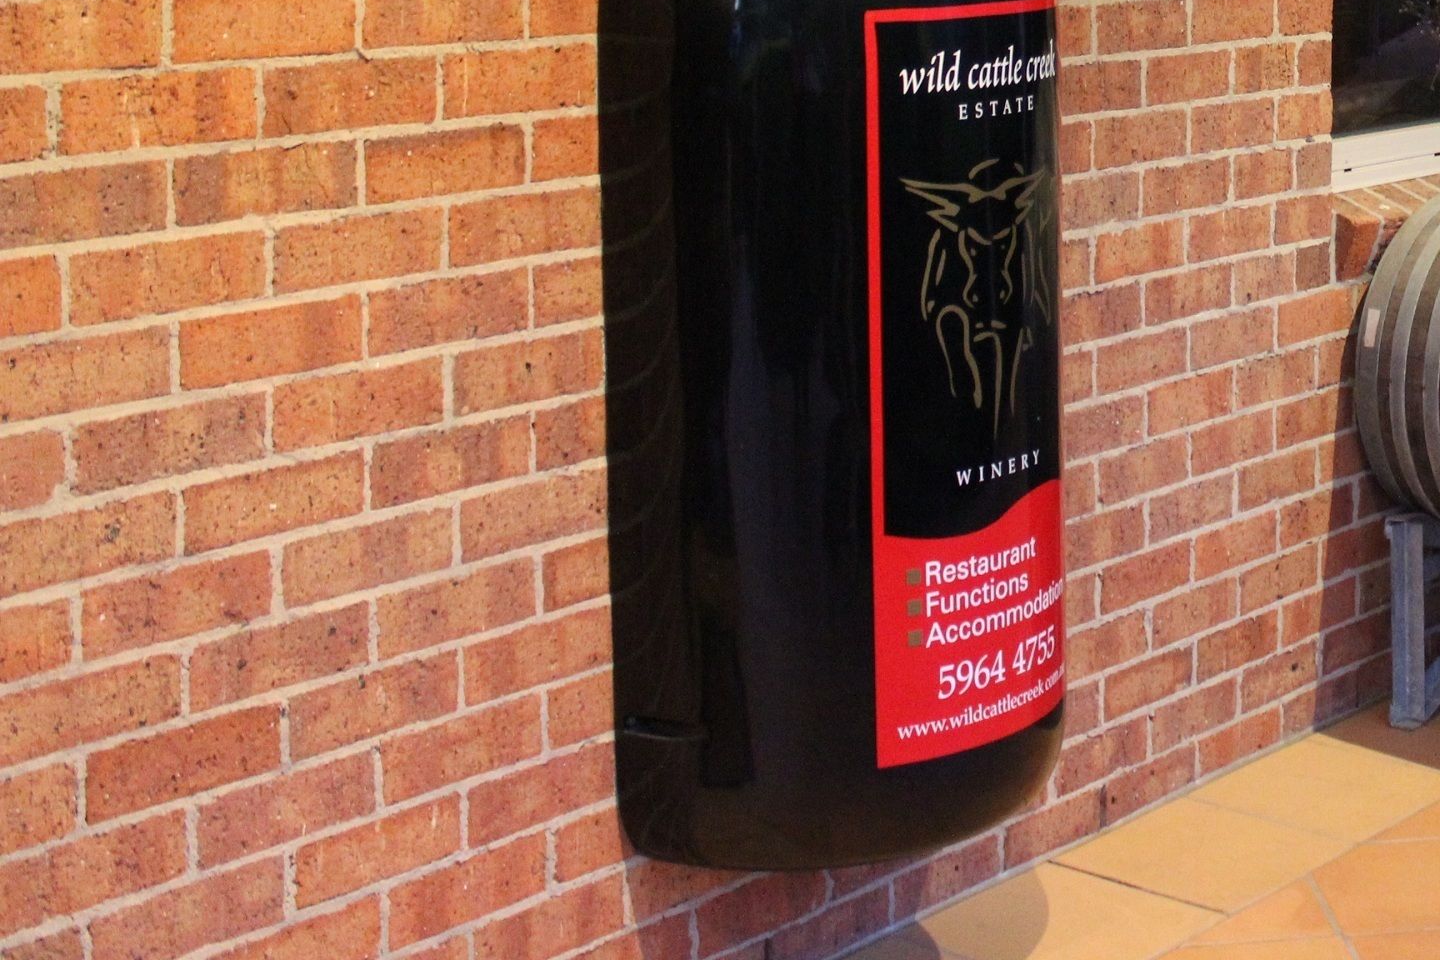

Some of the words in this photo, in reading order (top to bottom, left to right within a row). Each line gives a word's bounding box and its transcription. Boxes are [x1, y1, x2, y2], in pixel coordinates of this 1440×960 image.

[899, 50, 962, 95] wild
[967, 44, 1022, 90] cattle
[1026, 38, 1056, 82] creek
[958, 95, 1035, 120] ESTATE
[956, 448, 1041, 487] WINERY
[925, 536, 1036, 587] Restaurant
[926, 572, 1029, 618] Functions
[938, 649, 1006, 700] 5964
[1012, 624, 1056, 676] 4755
